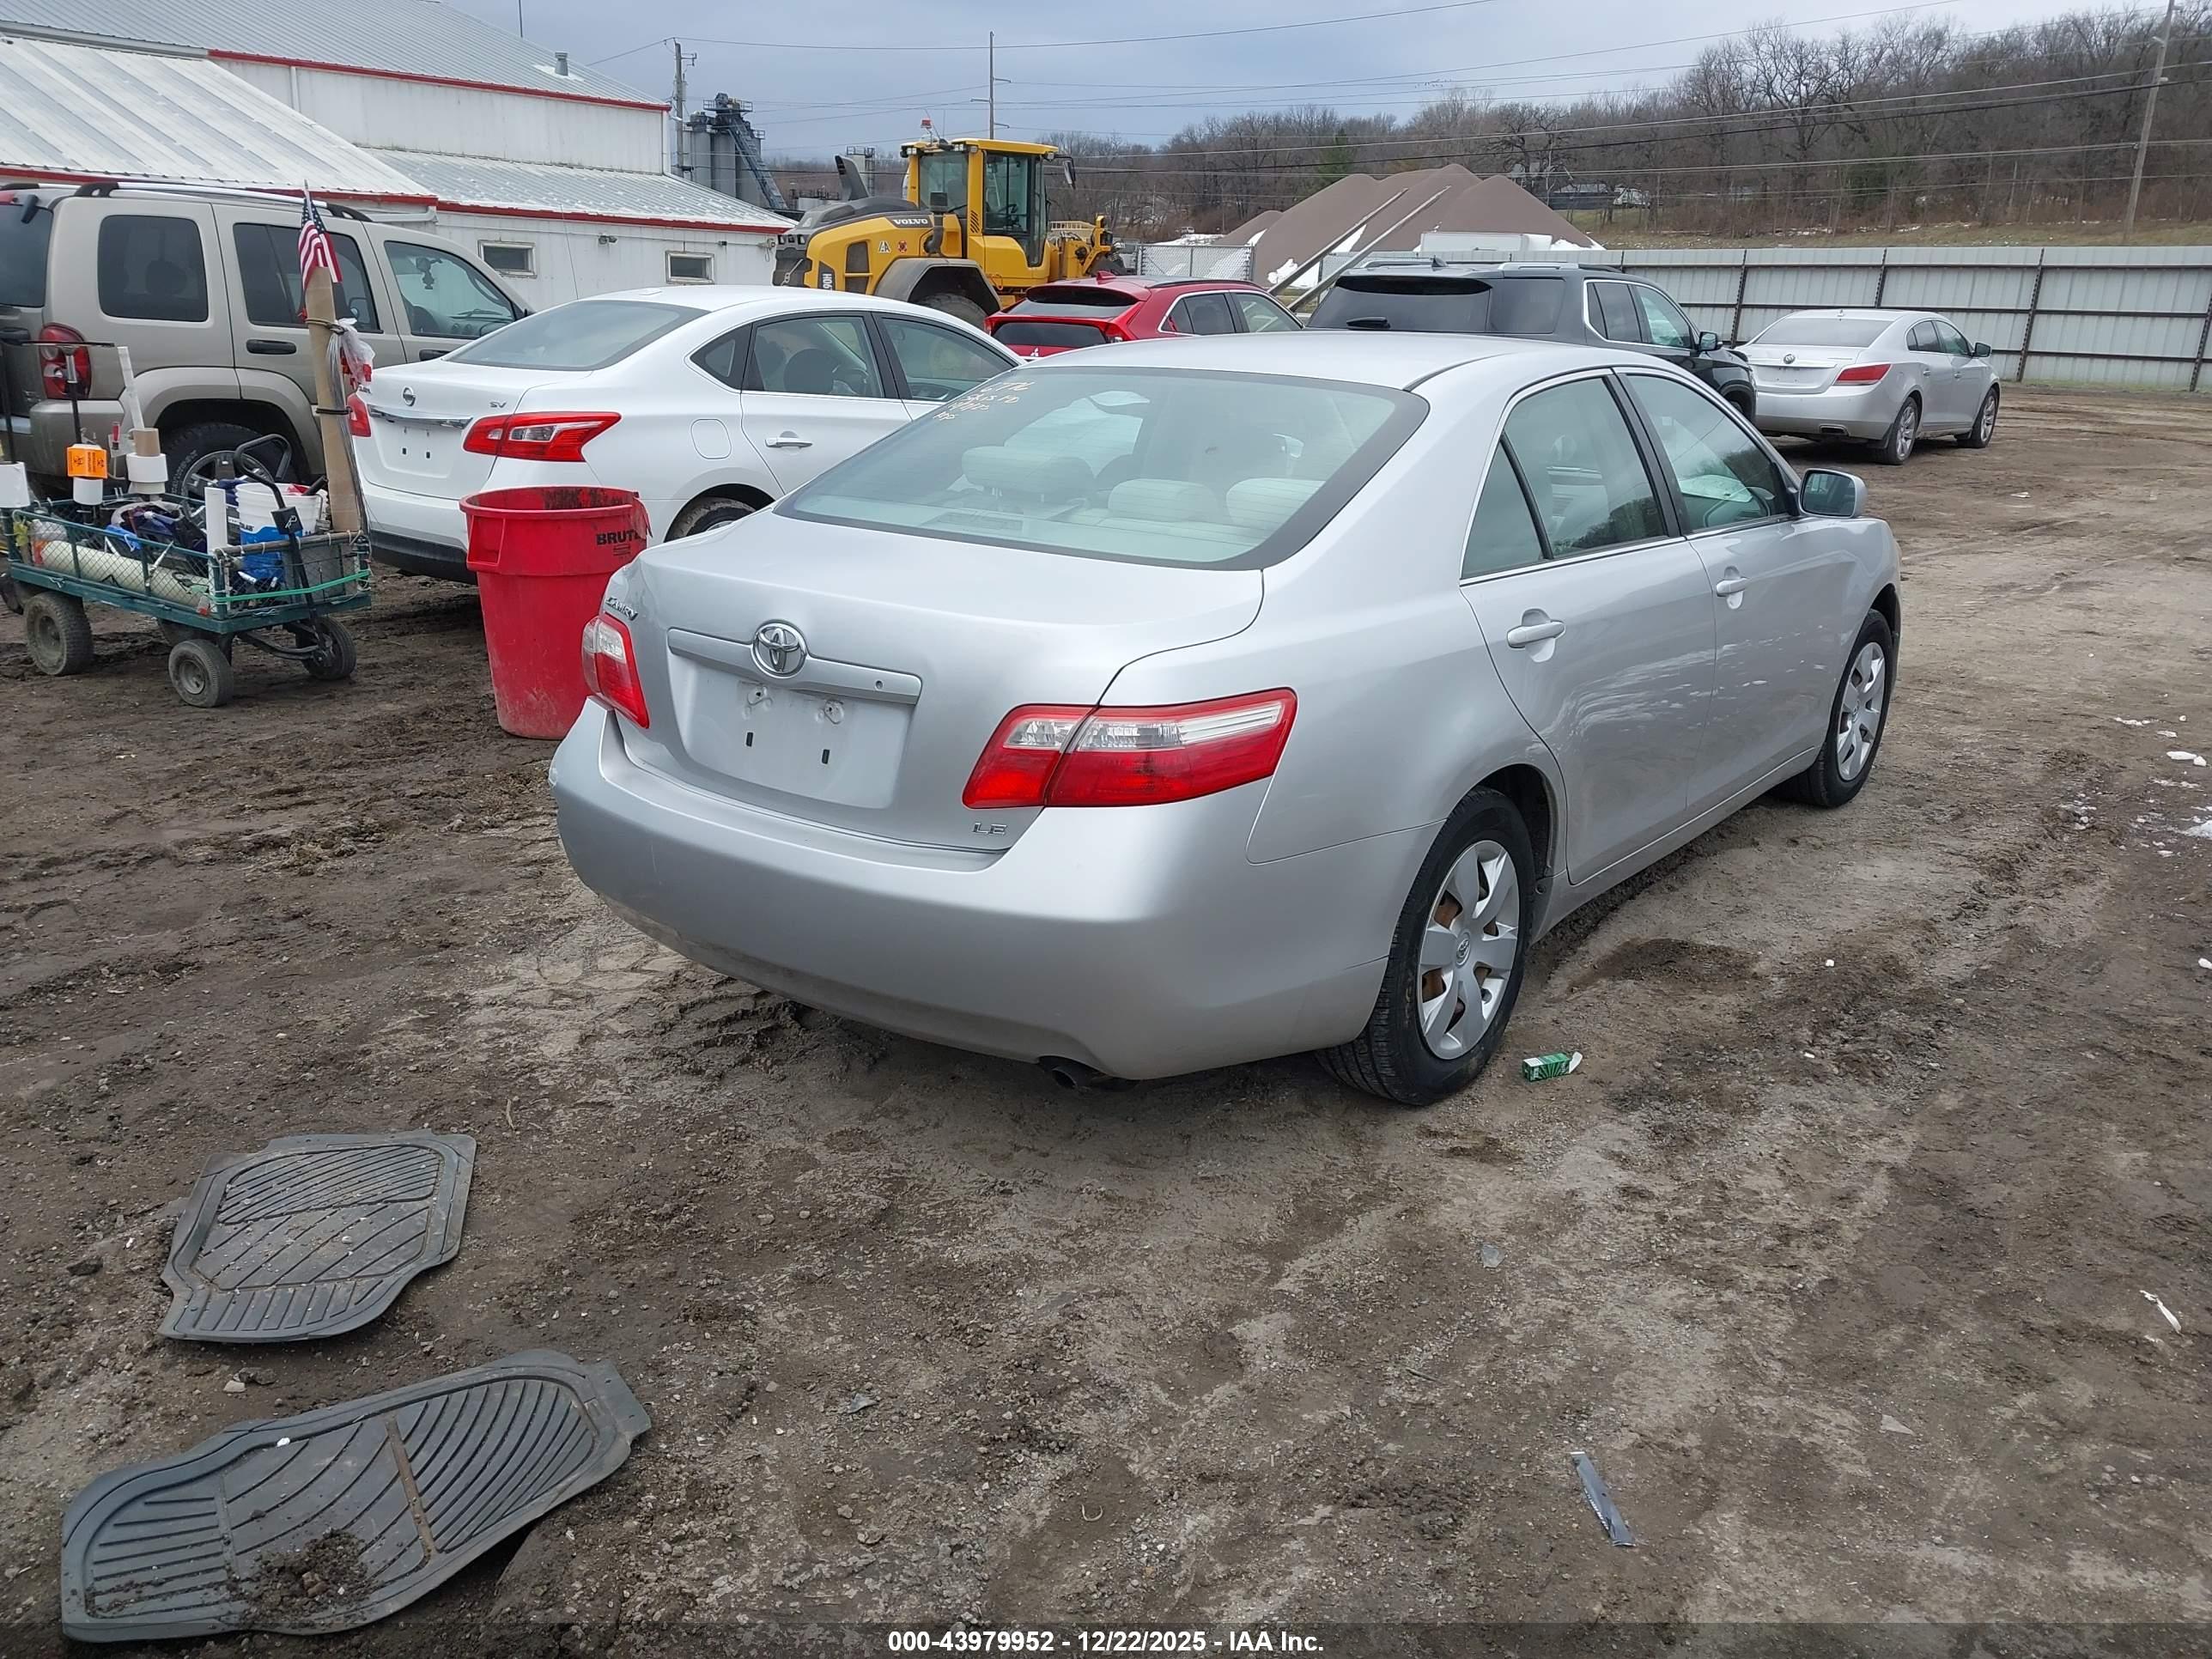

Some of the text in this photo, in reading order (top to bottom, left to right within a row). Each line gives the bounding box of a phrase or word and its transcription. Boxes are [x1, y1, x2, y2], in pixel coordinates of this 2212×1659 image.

[822, 273, 833, 291] 90H
[605, 596, 639, 622] CAMRY
[972, 822, 1008, 836] LE
